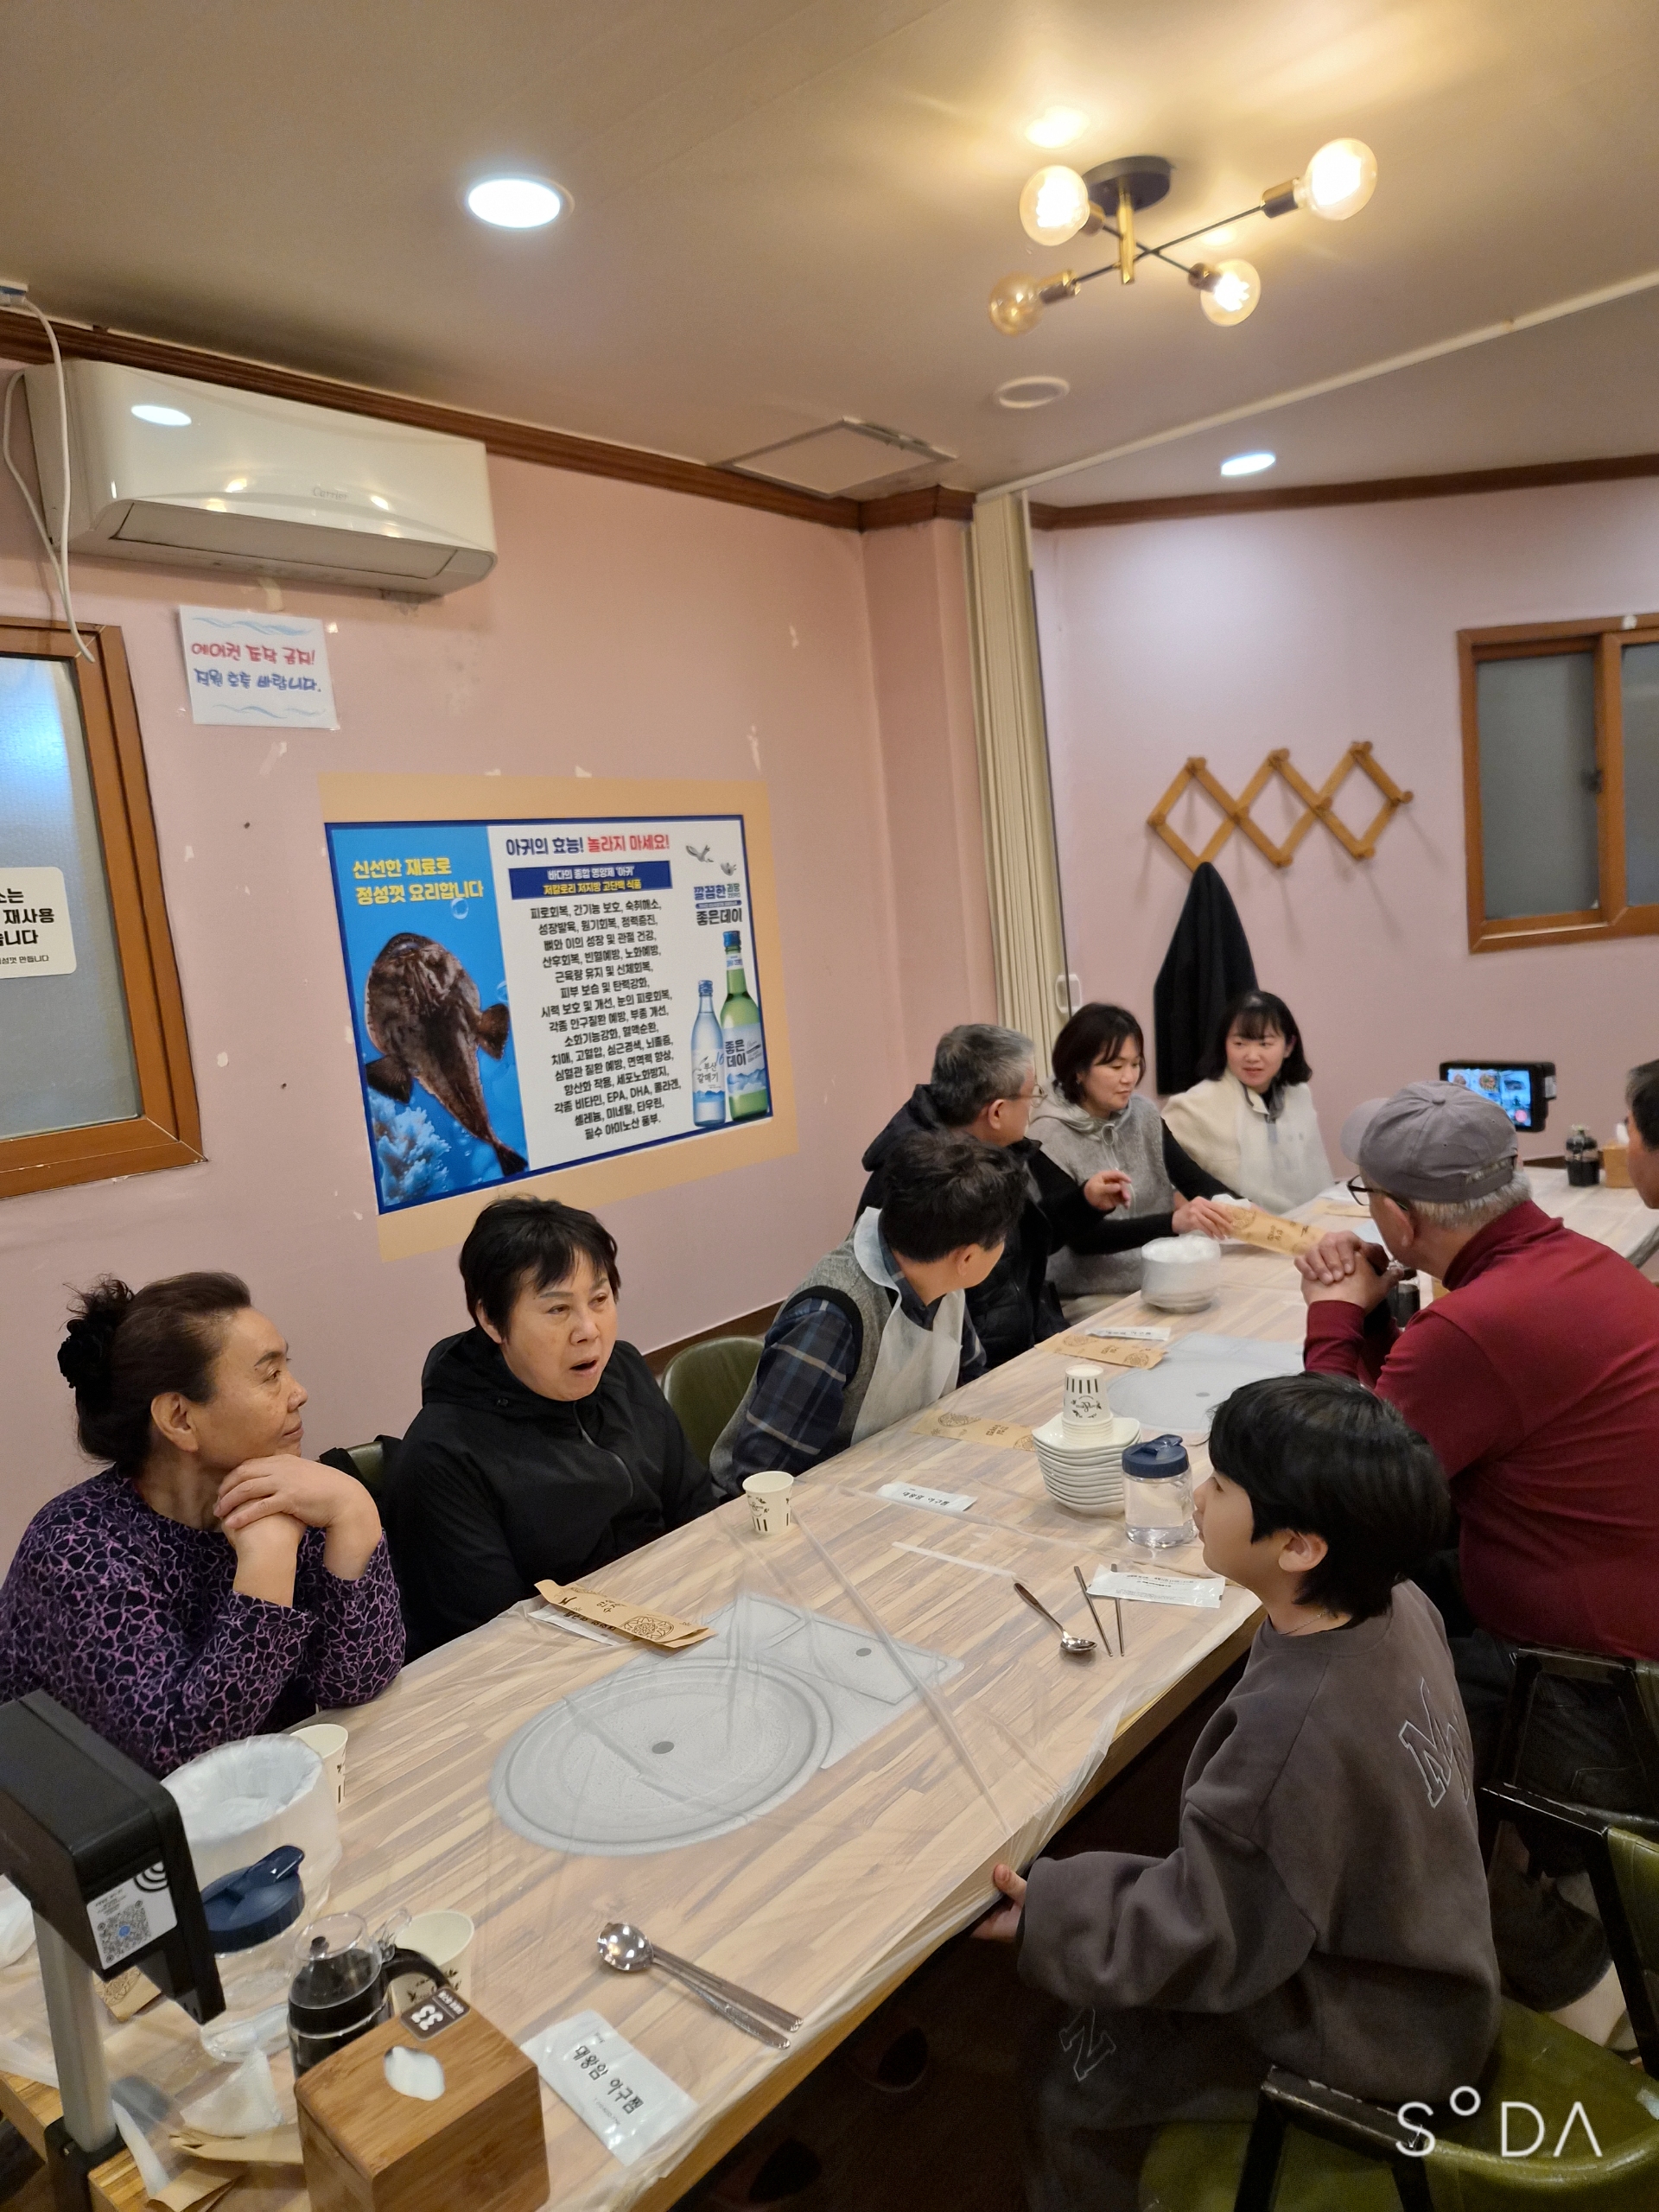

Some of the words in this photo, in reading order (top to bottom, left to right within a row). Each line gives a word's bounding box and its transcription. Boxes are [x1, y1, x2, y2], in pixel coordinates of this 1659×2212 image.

[194, 668, 223, 687] 직원
[505, 838, 549, 856] 아귀의
[551, 836, 584, 855] 효능!
[586, 835, 626, 854] 놀라지
[629, 834, 671, 851] 마세요!
[353, 859, 403, 880] 신선한
[404, 857, 452, 876] 재료로
[547, 868, 573, 880] 바다의
[356, 884, 406, 906] 정성껏
[409, 880, 484, 901] 요리합니다
[543, 883, 576, 895] 저칼로리
[577, 881, 601, 893] 저지방
[3, 908, 54, 925] 재사용
[530, 906, 571, 920] 피로회복,
[574, 904, 601, 916] 간기능
[603, 901, 624, 914] 보호,
[625, 899, 662, 912] 숙취해소,
[696, 908, 742, 926] 좋은데이
[538, 921, 579, 936] 성장발육,
[581, 918, 620, 931] 원기회복,
[565, 937, 584, 949] 이의
[586, 935, 604, 947] 성장
[607, 933, 615, 945] 및
[618, 932, 635, 944] 관절
[637, 930, 657, 942] 건강,
[543, 954, 583, 969] 산후회복,
[585, 950, 623, 964] 빈혈예방,
[625, 944, 662, 959] 노화예방,
[555, 969, 583, 983] 근육량
[585, 967, 603, 980] 유지
[605, 965, 615, 976] 및
[617, 961, 653, 976] 신체회복,
[560, 986, 579, 999] 피부
[582, 983, 600, 995] 보습
[601, 981, 612, 993] 및
[613, 976, 650, 991] 탄력강화,
[541, 1004, 561, 1018] 시력
[563, 1002, 582, 1015] 보호
[583, 1001, 593, 1012] 및
[594, 997, 616, 1010] 개선,
[617, 995, 635, 1007] 눈의
[636, 989, 673, 1004] 피로회복,
[549, 1020, 568, 1033] 각종
[570, 1014, 607, 1030] 안구질환
[608, 1011, 629, 1024] 예방,
[650, 1005, 670, 1017] 개선,
[564, 1027, 621, 1047] 소화기능강화,
[622, 1021, 659, 1038] 혈액순환,
[551, 1052, 574, 1065] 치매,
[575, 1046, 605, 1062] 고혈압,
[607, 1039, 645, 1056] 심근경색,
[725, 1039, 745, 1054] 좋은
[555, 1066, 583, 1082] 심혈관
[585, 1063, 603, 1077] 질환
[605, 1058, 626, 1072] 예방,
[627, 1053, 653, 1069] 면역력
[727, 1052, 747, 1068] 데이
[563, 1081, 592, 1096] 항산화
[594, 1076, 614, 1089] 작용,
[616, 1065, 670, 1085] 세포노화방지,
[554, 1100, 573, 1114] 각종
[575, 1094, 605, 1109] 비타민,
[607, 1090, 628, 1103] EPA,
[630, 1085, 653, 1099] DHA,
[607, 1103, 635, 1119] 미네랄,
[637, 1096, 665, 1112] 타우린,
[585, 1127, 603, 1141] 필수
[605, 1118, 640, 1135] 아미노산
